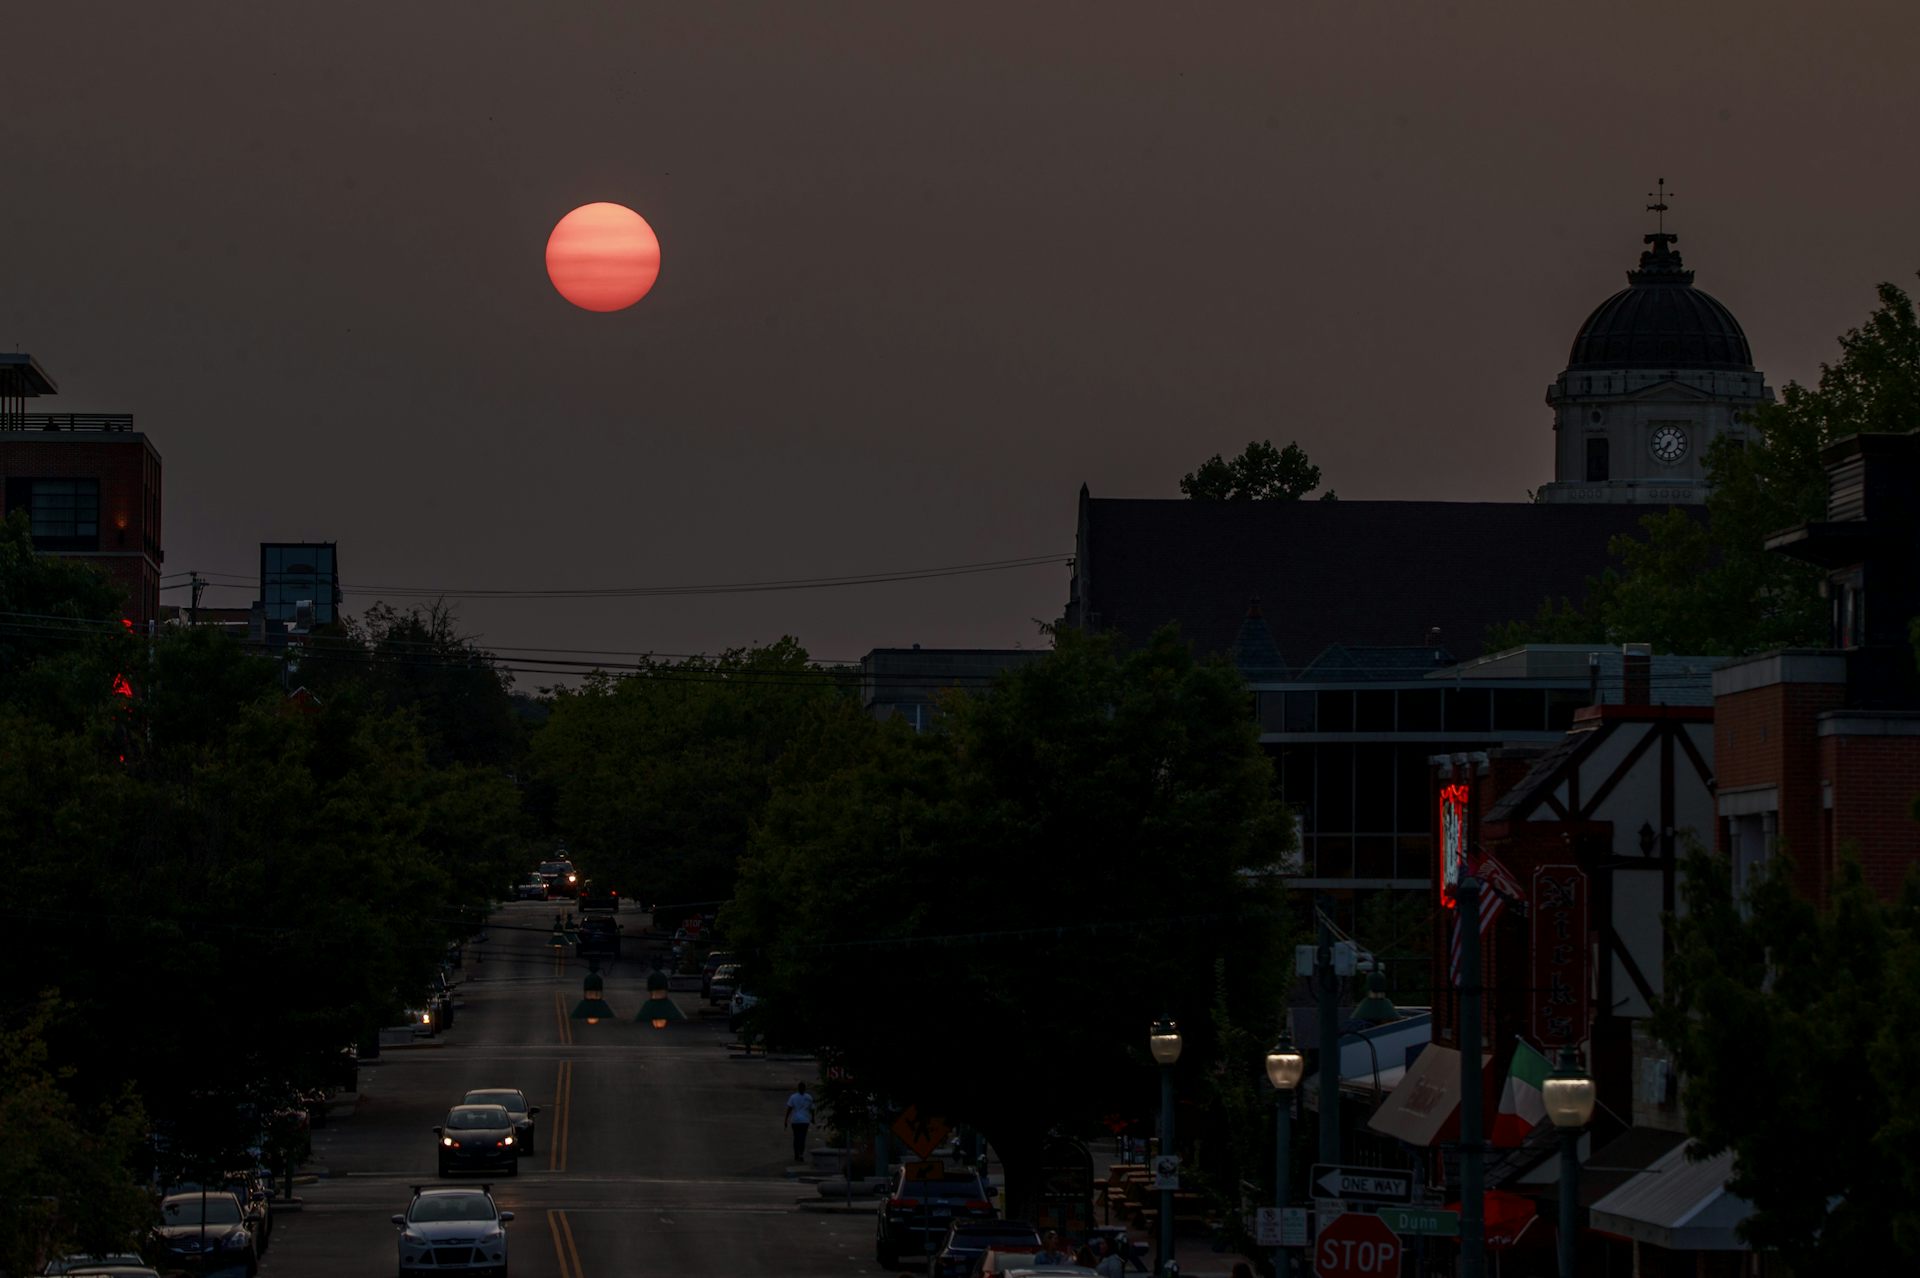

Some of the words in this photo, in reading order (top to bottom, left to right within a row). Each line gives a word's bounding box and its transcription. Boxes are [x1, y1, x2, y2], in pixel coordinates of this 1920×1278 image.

[1538, 875, 1580, 1038] Nick's
[1341, 1176, 1369, 1192] ONE
[1374, 1179, 1402, 1194] WAY
[1398, 1213, 1438, 1230] Dunn
[1320, 1238, 1395, 1273] STOP
